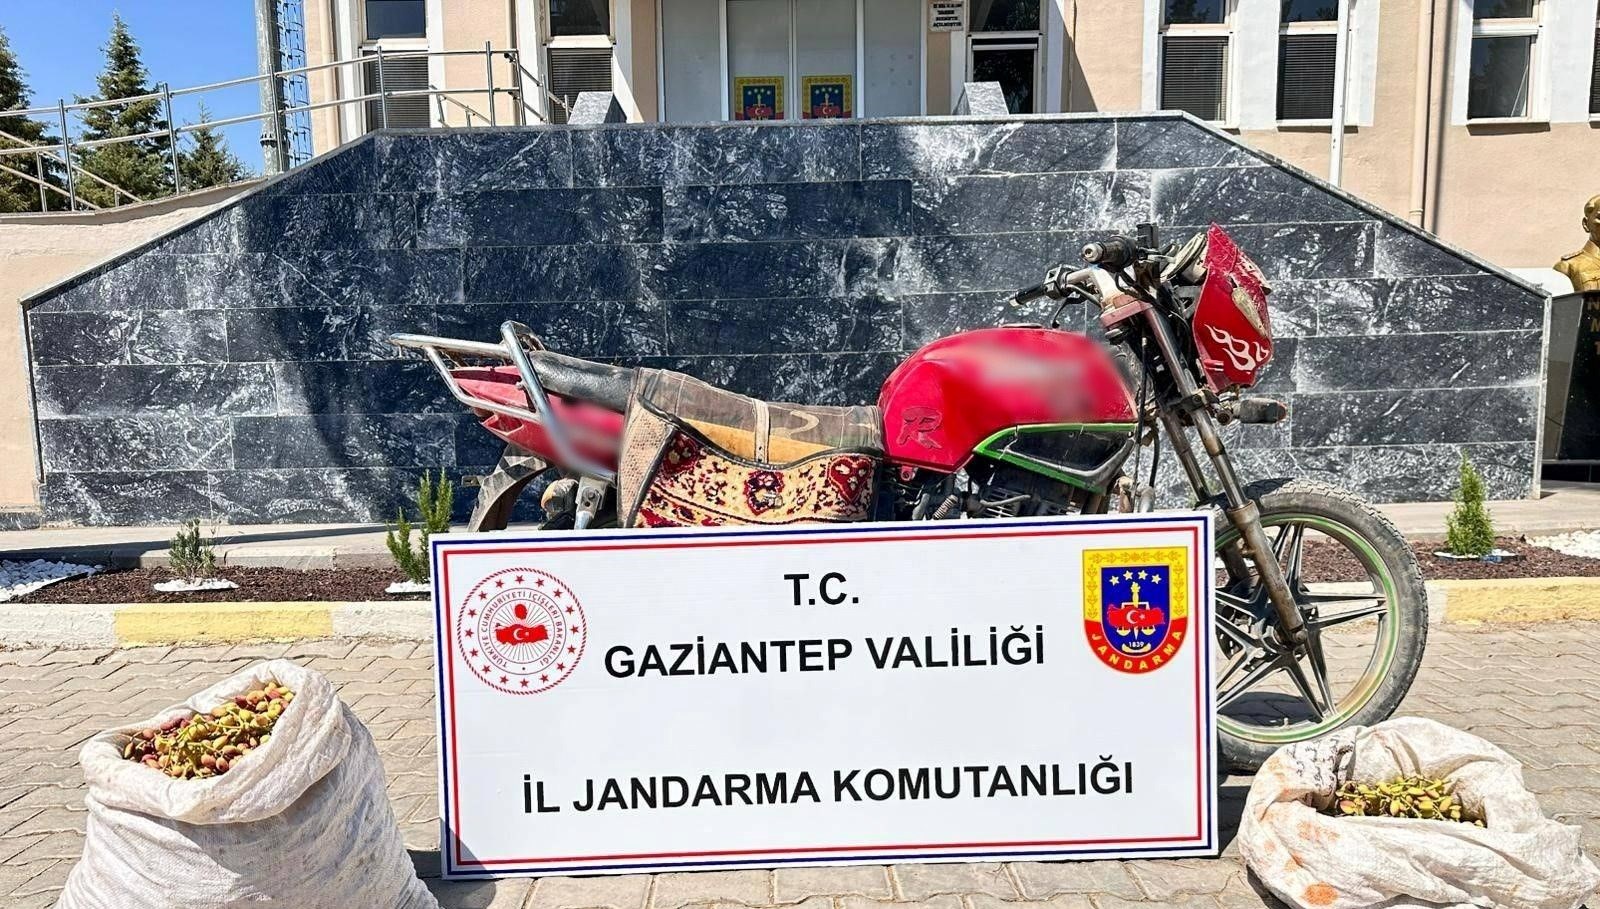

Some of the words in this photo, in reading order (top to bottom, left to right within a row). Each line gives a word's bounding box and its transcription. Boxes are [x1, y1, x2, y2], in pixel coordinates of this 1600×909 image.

[783, 571, 860, 606] T.C.
[604, 635, 853, 679] GAZİANTEP
[865, 624, 1044, 672] VALİLİĞİ
[1091, 631, 1183, 670] JANDARMA
[523, 774, 561, 814] İL
[572, 771, 821, 812] JANDARMA
[833, 754, 1133, 802] KOMUTANLIĞI
